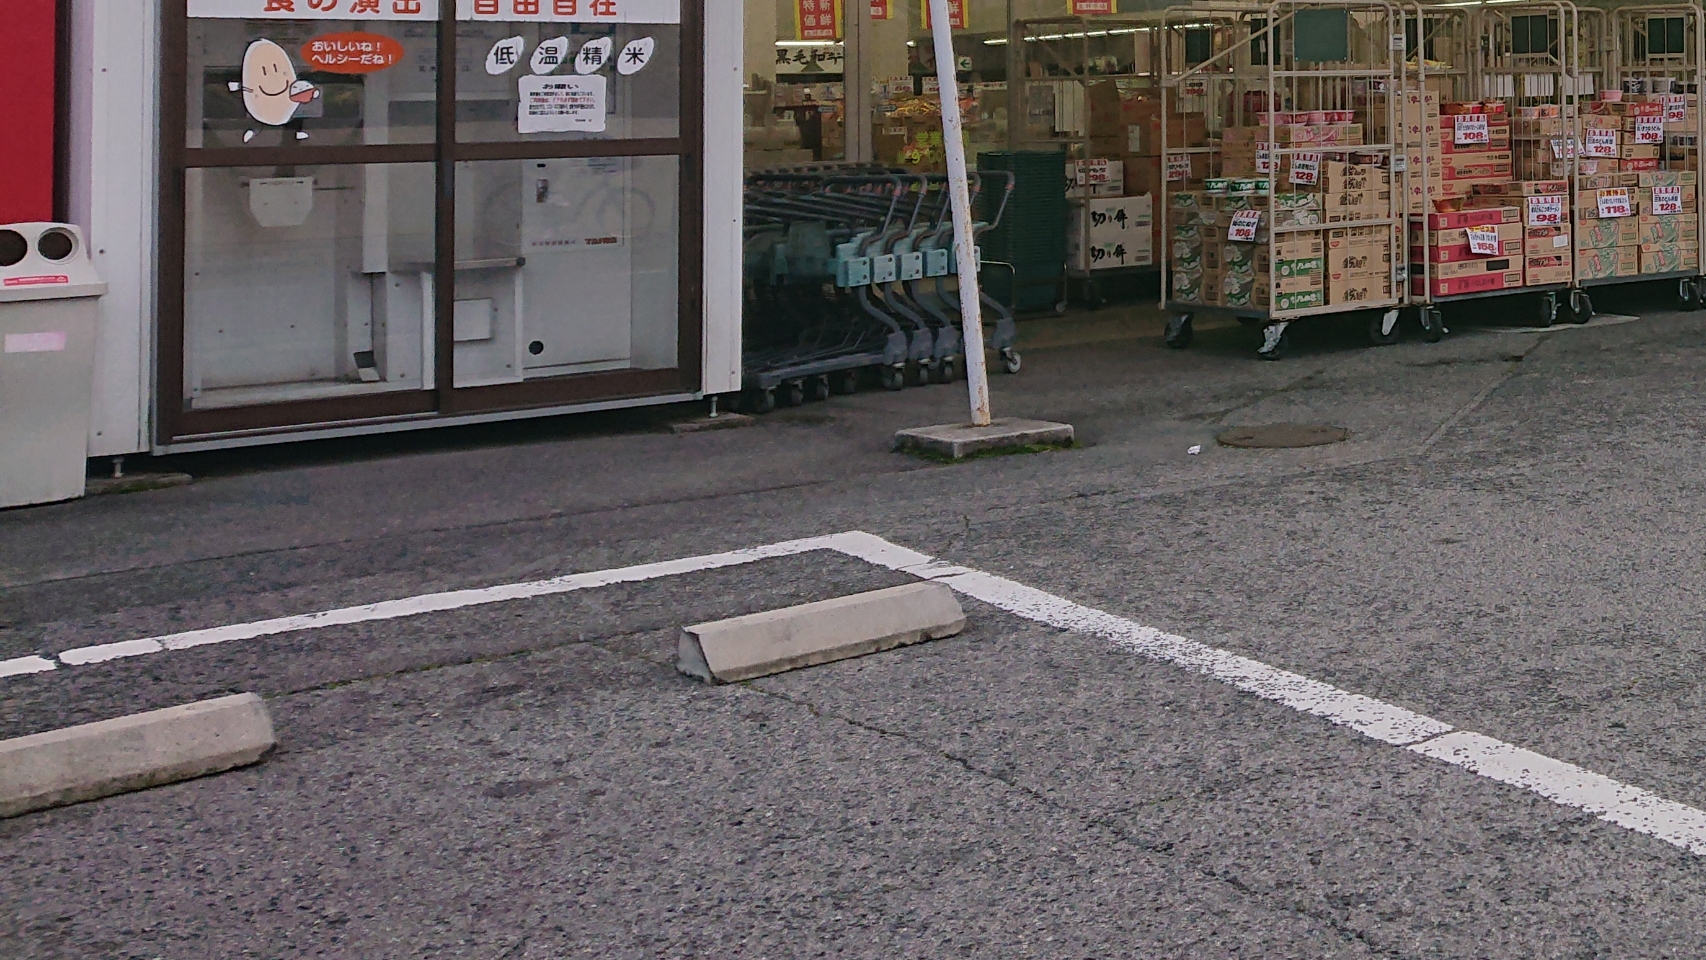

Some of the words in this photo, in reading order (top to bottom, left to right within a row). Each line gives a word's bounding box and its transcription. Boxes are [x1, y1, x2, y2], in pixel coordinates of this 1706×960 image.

[1463, 132, 1484, 140] 108
[1640, 132, 1659, 140] 108
[1594, 145, 1612, 154] 128
[1294, 171, 1313, 180] 128
[1605, 205, 1626, 214] 118
[1659, 203, 1677, 211] 128
[1536, 214, 1558, 222] 98
[1235, 228, 1252, 237] 108
